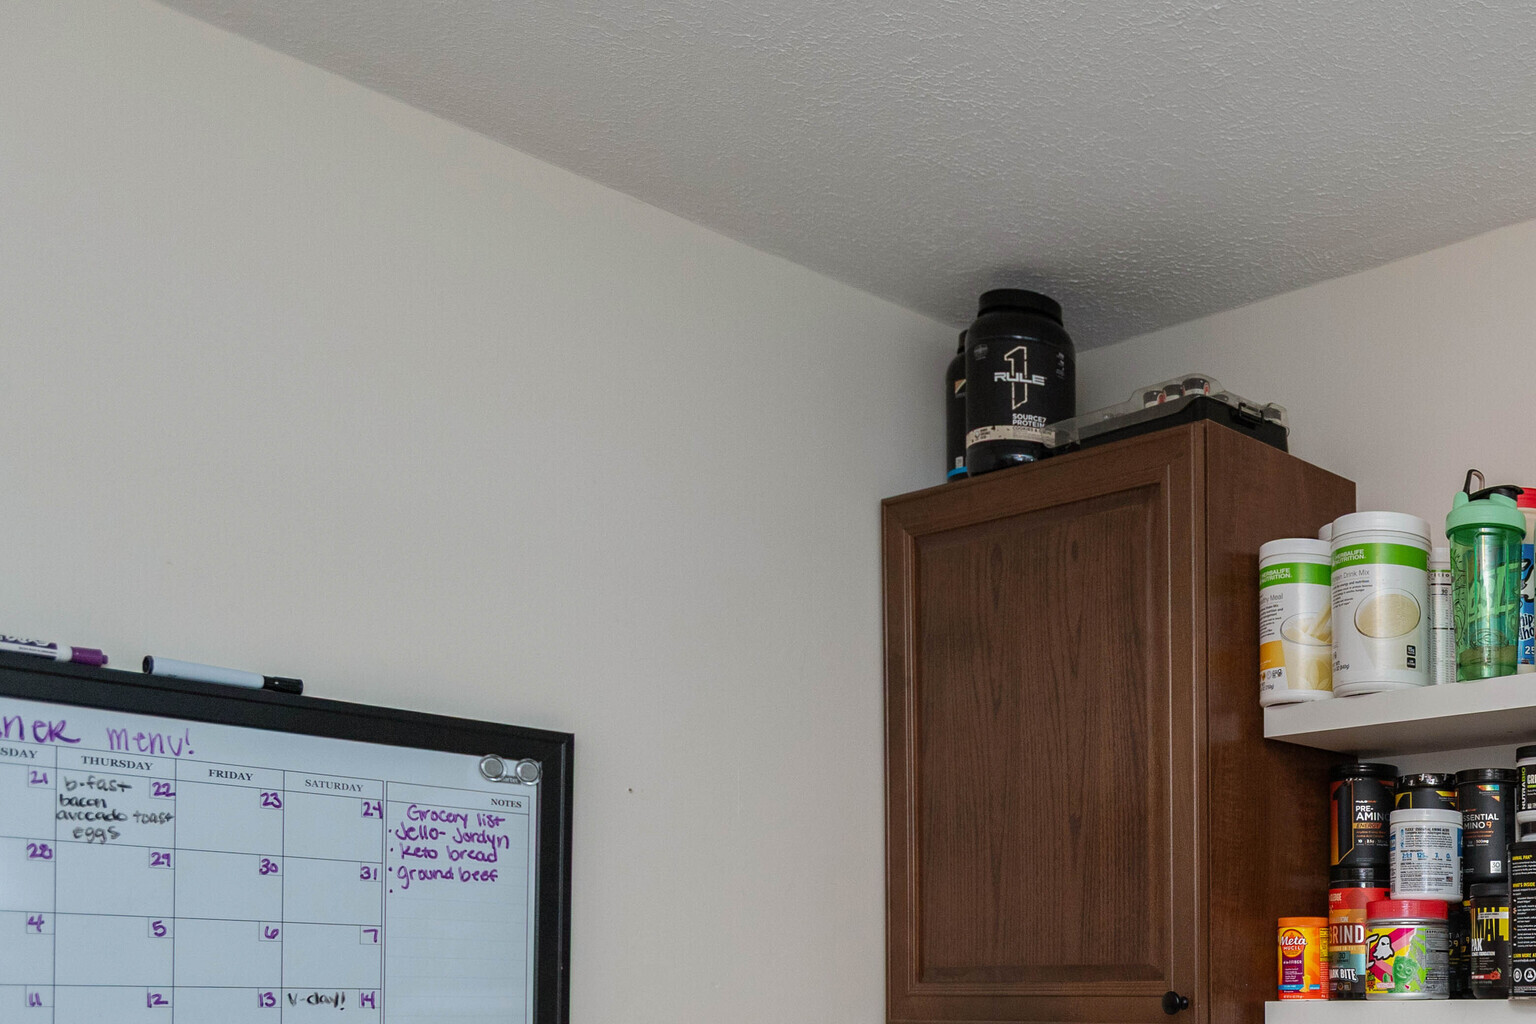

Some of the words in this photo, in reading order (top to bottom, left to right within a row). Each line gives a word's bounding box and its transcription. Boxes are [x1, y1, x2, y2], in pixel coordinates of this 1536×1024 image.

[994, 372, 1045, 386] RULE
[1012, 413, 1047, 423] SOURCE7
[1270, 593, 1283, 601] Meal
[106, 728, 195, 756] menu!
[81, 756, 154, 771] THURSDAY
[208, 769, 254, 781] FRIDAY
[305, 779, 364, 792] SATURDAY
[491, 798, 522, 808] NOTES
[30, 771, 49, 784] 21
[152, 782, 176, 797] 22
[260, 792, 283, 808] 23
[362, 801, 383, 819] 24
[59, 793, 107, 808] bacon
[132, 810, 174, 824] toast
[407, 804, 468, 829] Grocery
[477, 813, 506, 828] list
[72, 826, 121, 843] eggs
[452, 829, 510, 849] Jordyn
[26, 843, 52, 860] 28
[150, 851, 171, 867] 29
[259, 858, 279, 875] 30
[360, 866, 378, 881] 31
[446, 845, 498, 863] bread
[397, 865, 454, 890] ground
[458, 867, 499, 883] beef
[28, 914, 45, 932] 4
[152, 920, 167, 937] 5
[264, 925, 280, 940] 6
[363, 928, 379, 943] 7
[1280, 936, 1307, 946] Meta
[1340, 968, 1357, 980] BITE
[28, 992, 43, 1007] 11
[146, 992, 169, 1008] 12
[258, 992, 277, 1008] 13
[360, 992, 375, 1009] 14
